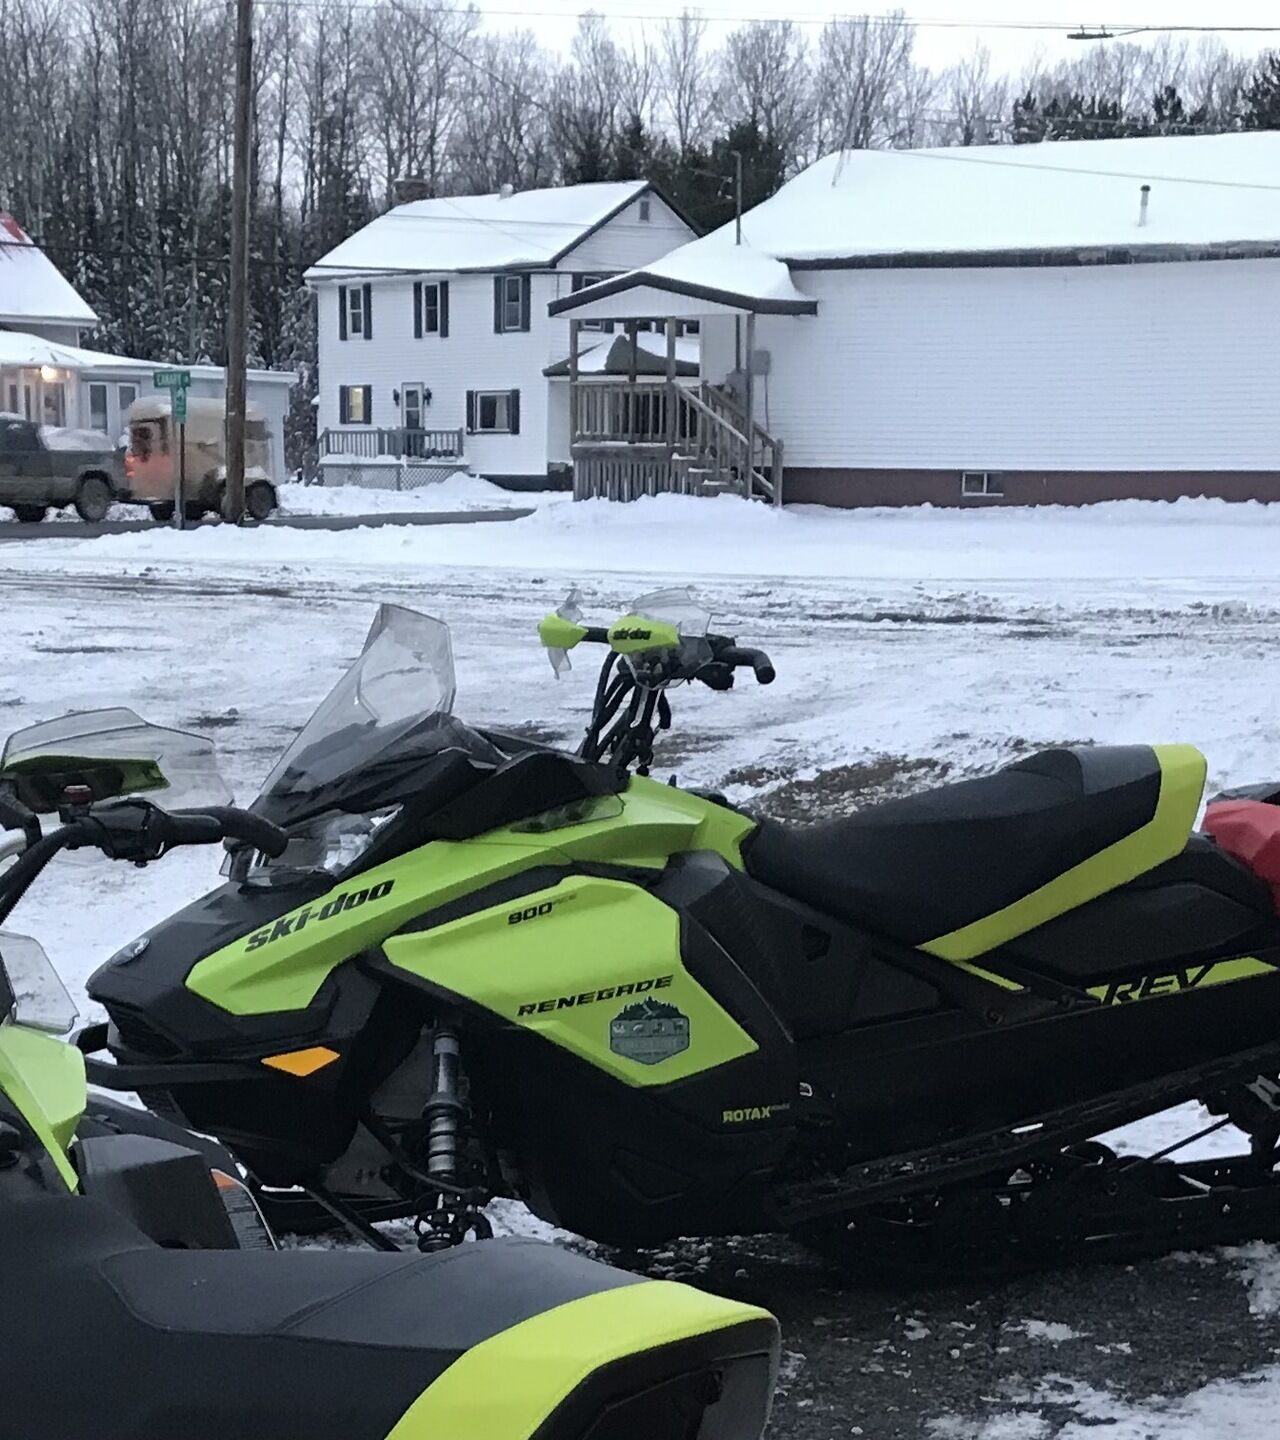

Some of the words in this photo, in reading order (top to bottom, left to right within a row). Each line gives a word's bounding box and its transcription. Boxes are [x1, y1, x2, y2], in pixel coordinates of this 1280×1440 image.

[245, 879, 395, 952] ski-doo
[517, 975, 674, 1017] RENEGADE
[1102, 962, 1216, 1006] REV
[723, 1106, 771, 1123] ROTAX
